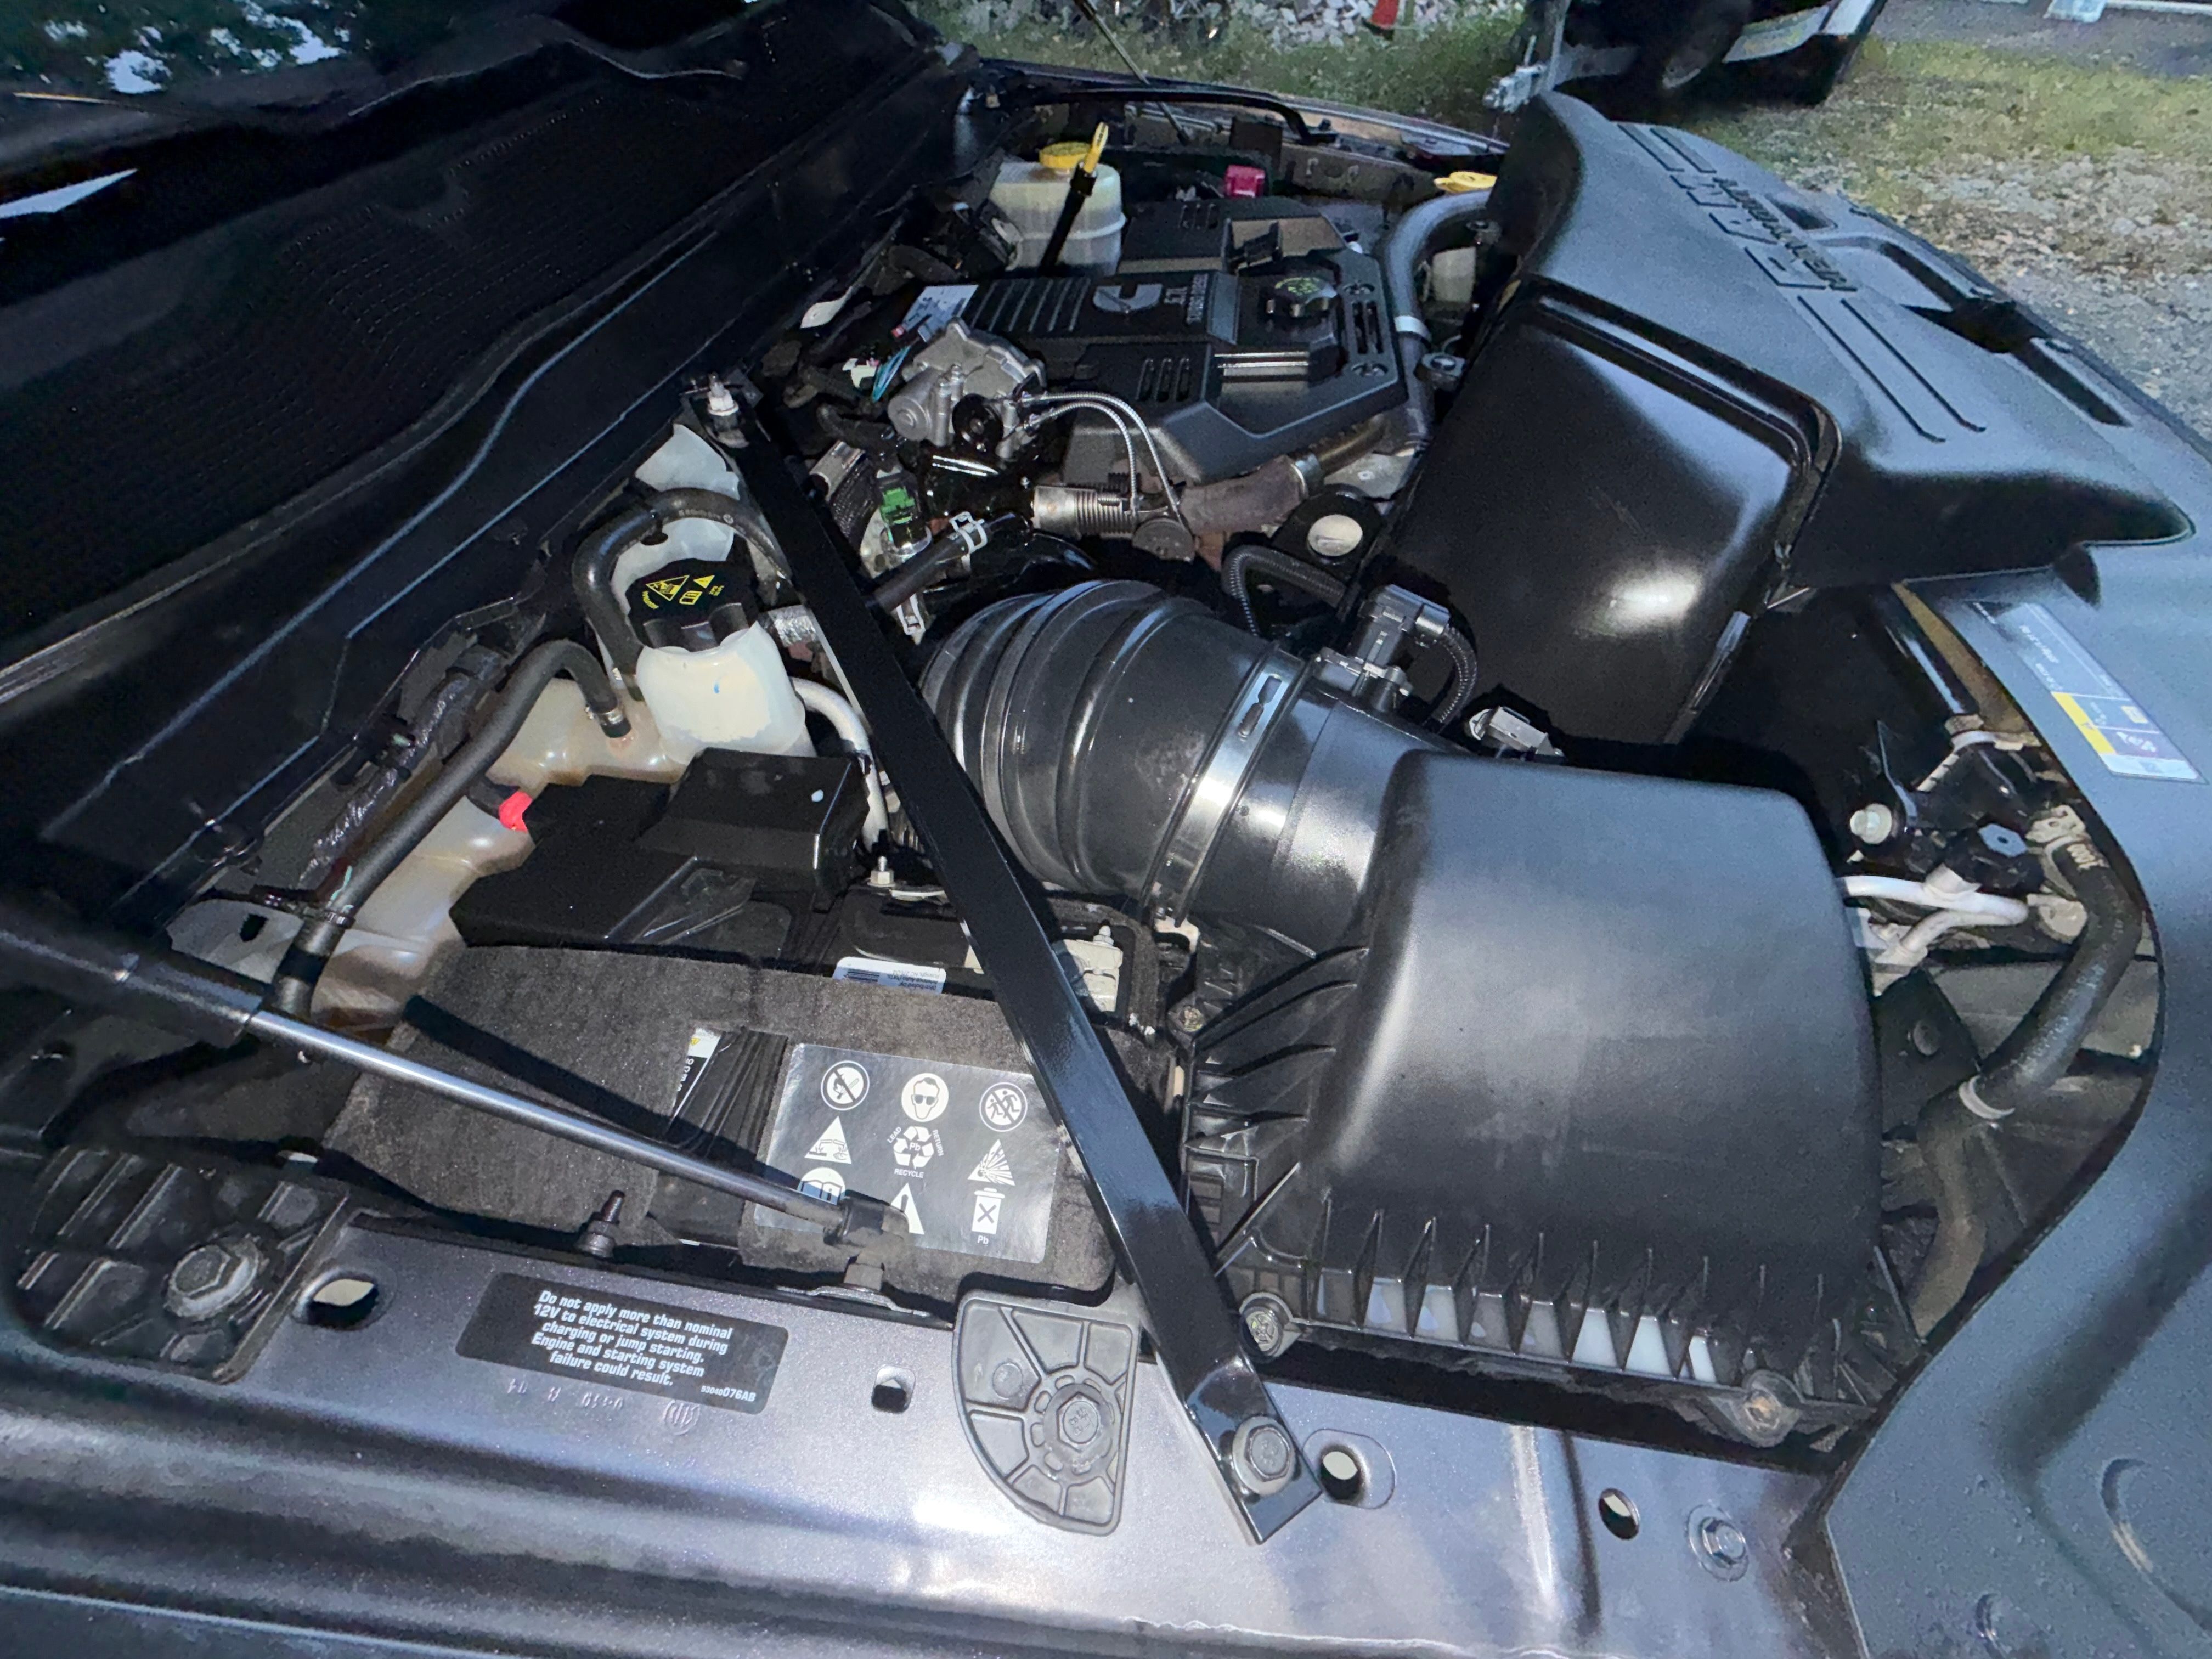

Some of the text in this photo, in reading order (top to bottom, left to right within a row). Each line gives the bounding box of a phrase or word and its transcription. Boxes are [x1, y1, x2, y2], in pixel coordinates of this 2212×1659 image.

[1669, 174, 1827, 289] RAM
[887, 1126, 902, 1144] LEAD
[909, 1142, 921, 1152] Pb
[932, 1129, 944, 1156] RETURN
[894, 1168, 924, 1178] RECYCLE
[977, 1235, 989, 1244] Pb
[534, 1304, 729, 1356] 12V to electrical system during
[539, 1290, 733, 1340] Do not apply more than nominal
[532, 1332, 705, 1378] Engine and starting system
[541, 1321, 704, 1363] charging or jump starting.
[549, 1351, 674, 1386] failure could result.
[701, 1385, 757, 1402] 53040076AB
